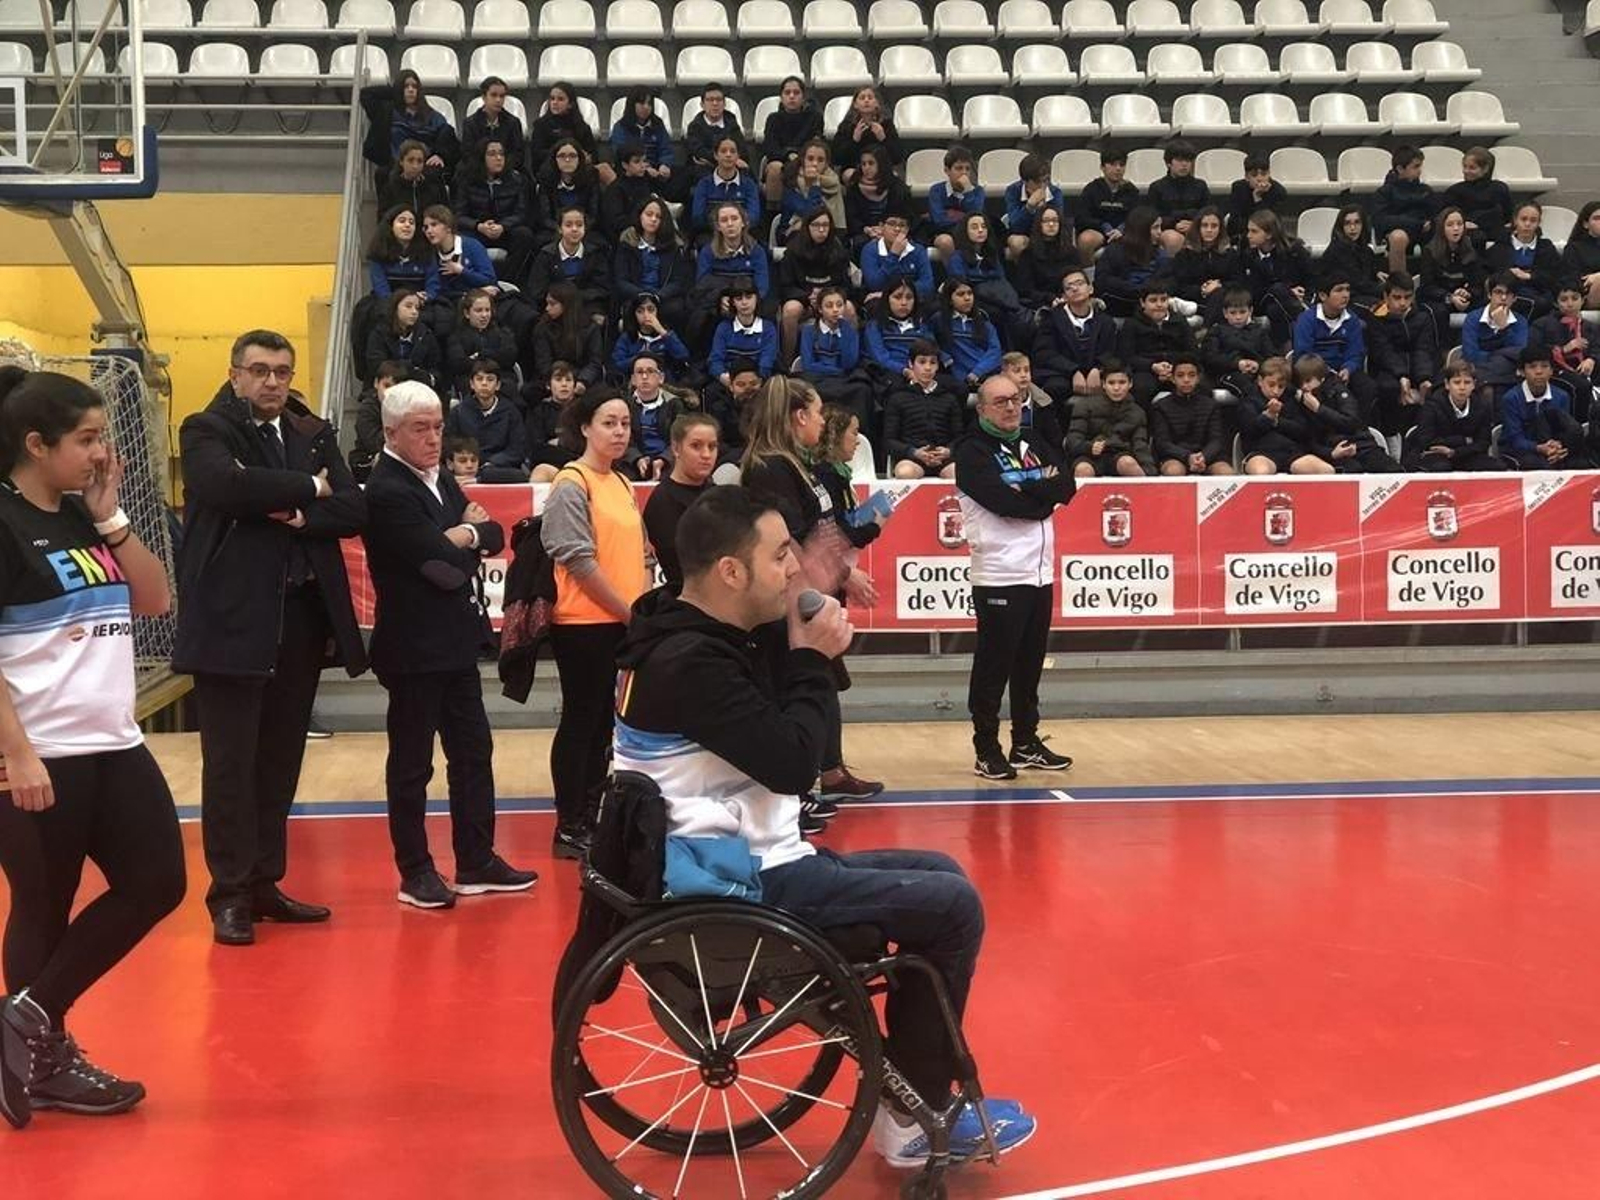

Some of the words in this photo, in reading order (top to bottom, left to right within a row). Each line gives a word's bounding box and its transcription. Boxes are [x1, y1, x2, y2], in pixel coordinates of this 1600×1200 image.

[1066, 558, 1170, 580] Concello
[1229, 555, 1334, 579] Concello
[1391, 551, 1496, 575] Concello
[907, 588, 936, 610] de
[1072, 587, 1100, 608] de
[1106, 586, 1158, 614] Vigo
[1235, 584, 1263, 606] de
[1269, 583, 1321, 611] Vigo
[1398, 580, 1426, 602] de
[1432, 579, 1484, 608] Vigo
[1561, 577, 1590, 599] de
